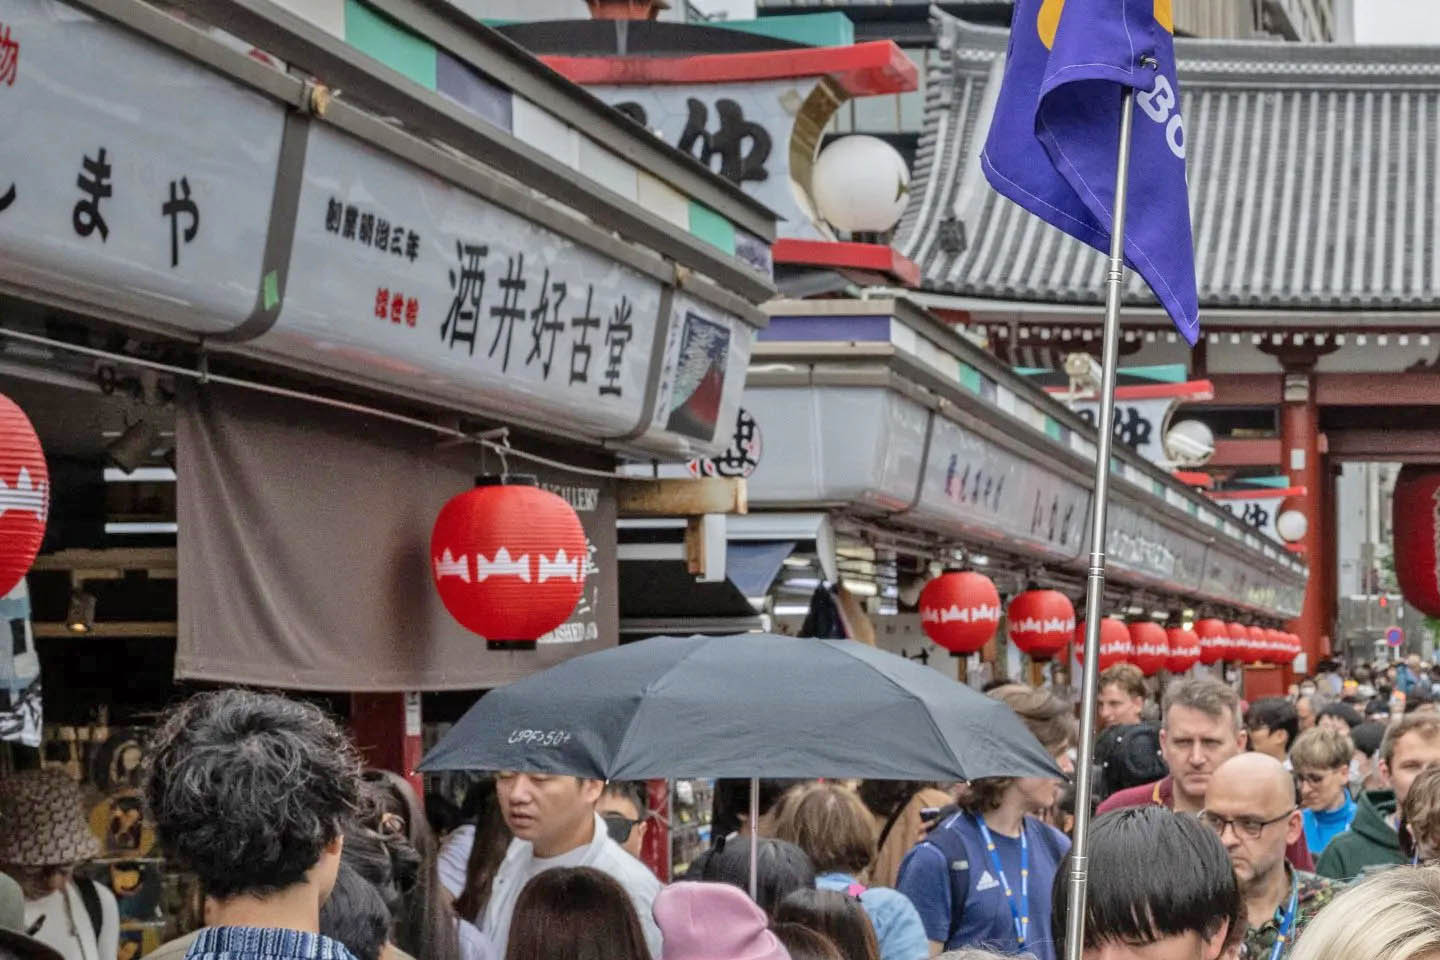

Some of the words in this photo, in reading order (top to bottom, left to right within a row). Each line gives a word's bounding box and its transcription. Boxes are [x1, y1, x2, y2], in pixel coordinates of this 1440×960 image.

[440, 240, 633, 396] 酒井好古堂
